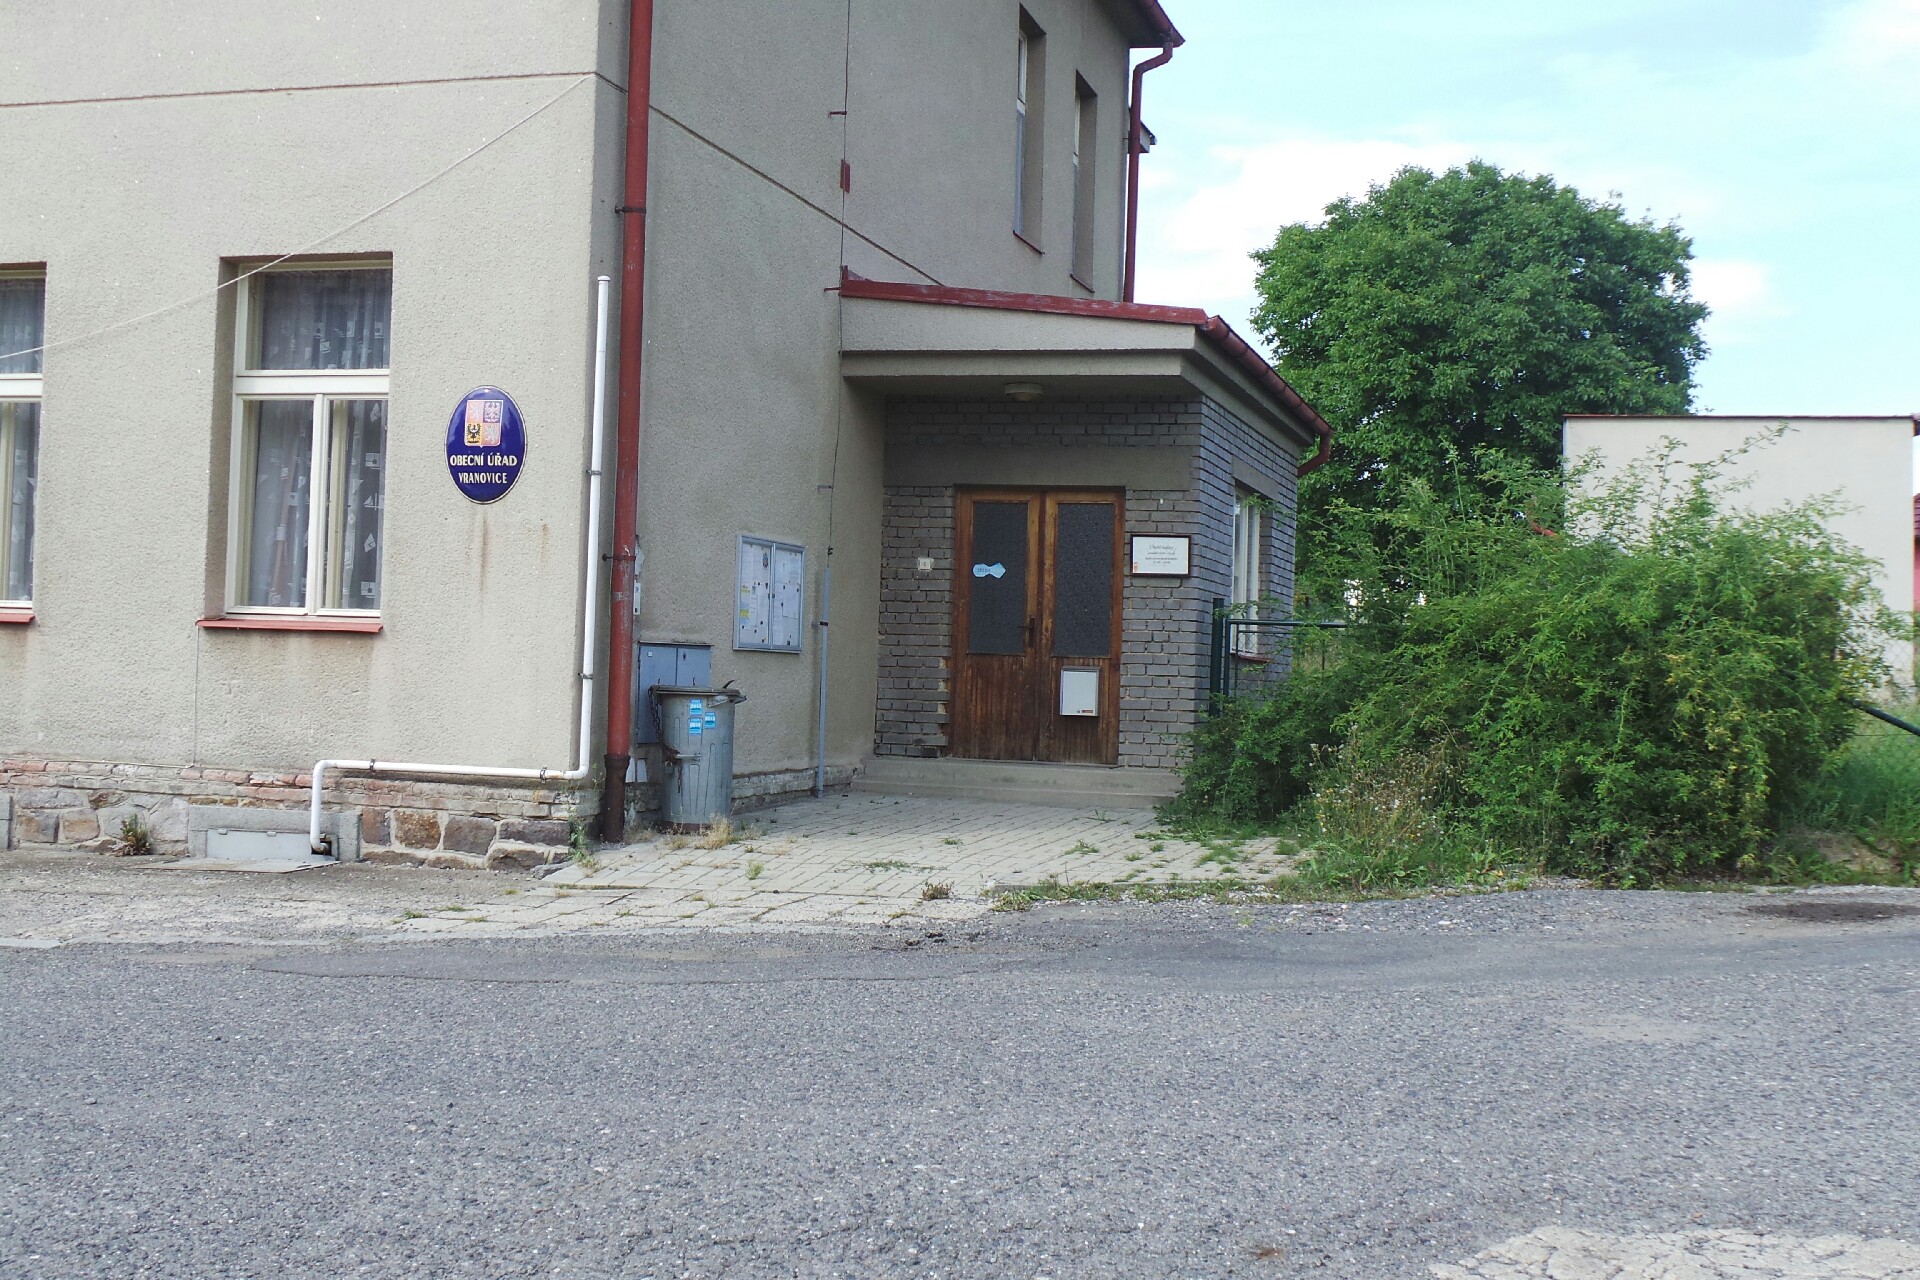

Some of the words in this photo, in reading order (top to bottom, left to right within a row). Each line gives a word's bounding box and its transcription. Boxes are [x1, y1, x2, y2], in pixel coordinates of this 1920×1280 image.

[449, 452, 485, 467] OBECNÍ
[487, 452, 518, 467] ÚŘAD
[458, 472, 508, 484] VRANOVICE
